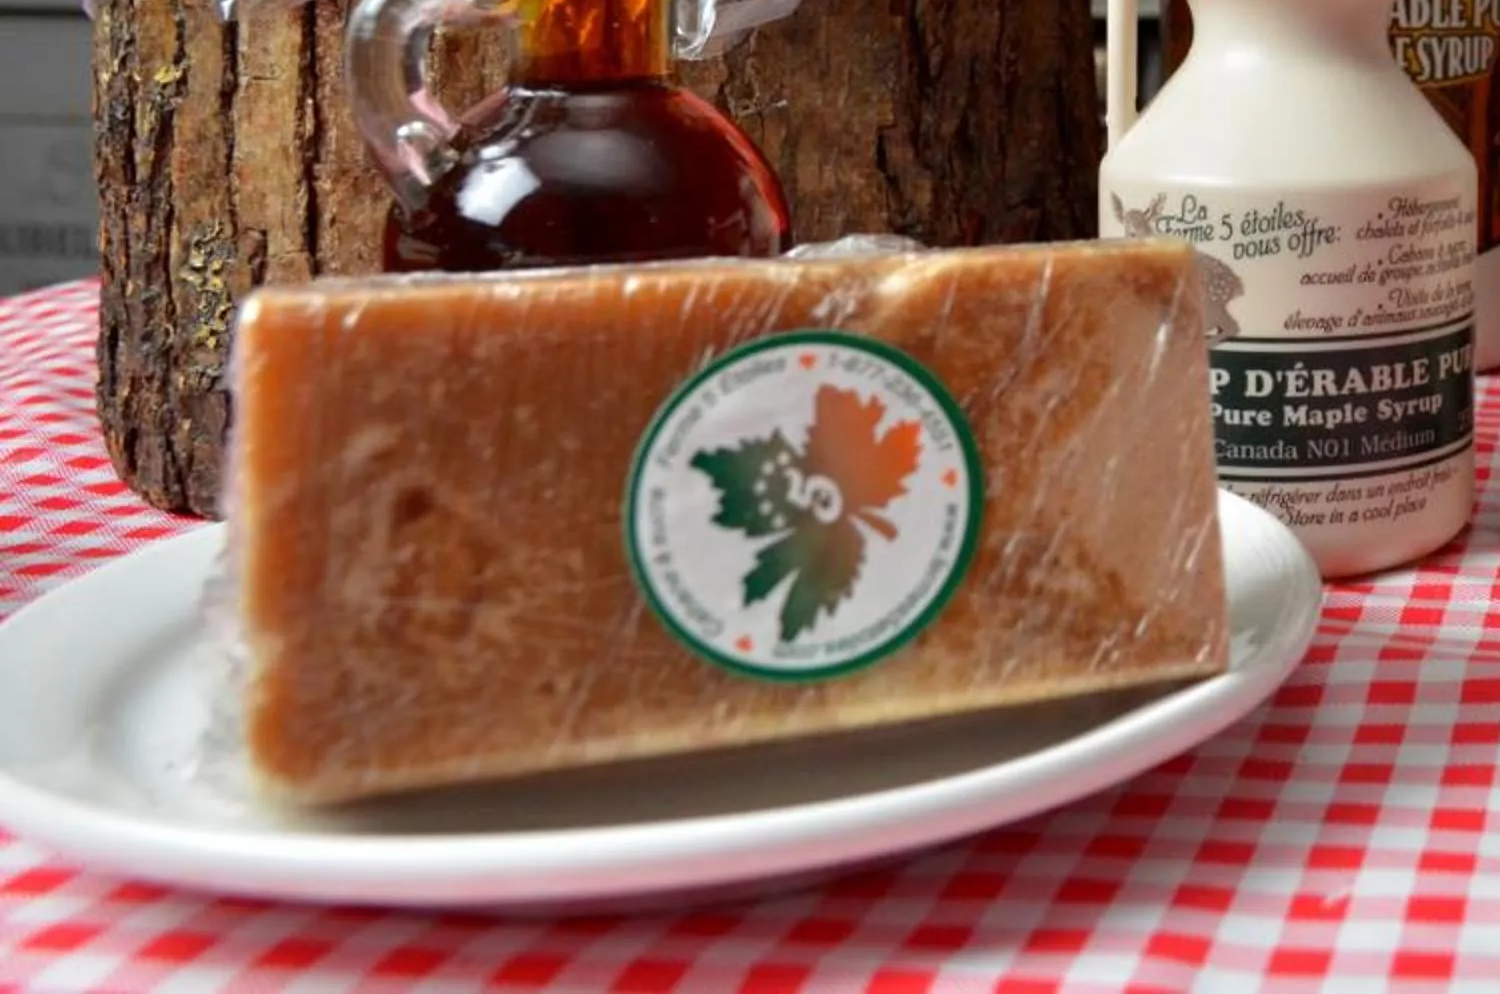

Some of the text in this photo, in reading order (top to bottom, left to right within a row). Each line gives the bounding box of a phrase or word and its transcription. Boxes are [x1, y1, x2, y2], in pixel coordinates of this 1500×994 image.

[1417, 35, 1494, 81] SYRUP
[1177, 194, 1208, 224] La
[1219, 214, 1234, 241] 5
[1240, 201, 1306, 236] étoiles
[1233, 237, 1281, 260] vous
[1300, 263, 1357, 285] accueil
[1358, 263, 1376, 283] de
[1245, 359, 1430, 398] D'ÉRABLE
[1211, 404, 1273, 427] Pure
[1282, 403, 1368, 430] Maple
[1376, 393, 1443, 423] Syrup
[1213, 439, 1299, 461] Canada
[1325, 484, 1364, 504] dans
[1365, 485, 1385, 500] un
[1329, 508, 1344, 524] in
[1349, 512, 1359, 523] a
[1362, 499, 1394, 520] cool
